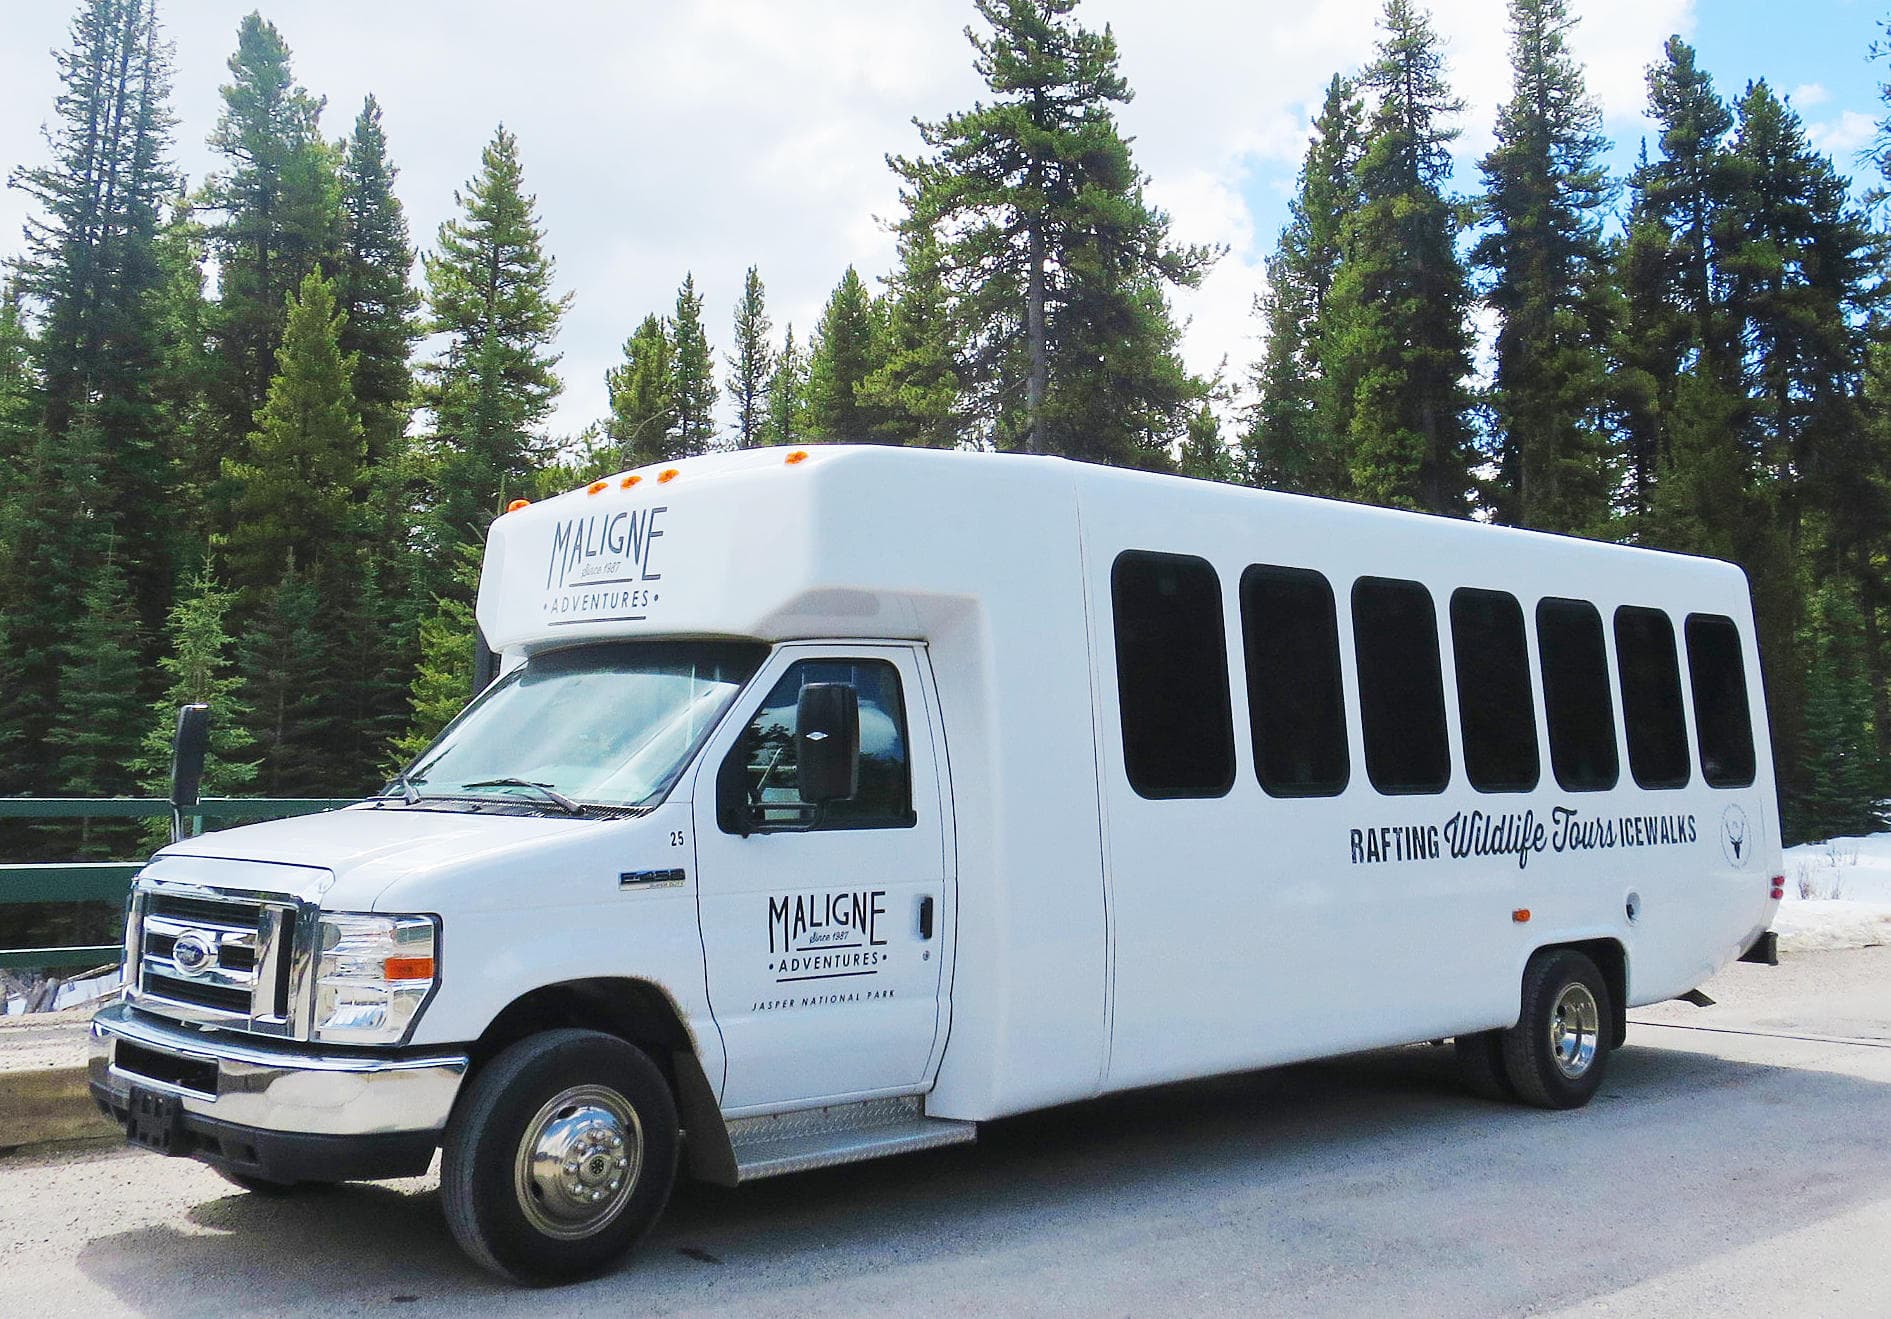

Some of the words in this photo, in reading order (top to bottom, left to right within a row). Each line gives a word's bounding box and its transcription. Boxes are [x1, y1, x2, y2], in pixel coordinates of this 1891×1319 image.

[547, 506, 668, 591] MALIGNE
[550, 590, 649, 614] ADVENTURES
[670, 830, 684, 847] 25
[1350, 825, 1440, 864] RAFTING
[1443, 809, 1548, 870] Wildlife
[1552, 806, 1618, 853] Tours
[1619, 814, 1698, 848] ICEWALKS
[768, 890, 888, 954] MALIGNE
[778, 951, 878, 973] ADVENTURES
[752, 999, 795, 1012] JASPER
[801, 992, 860, 1007] NATIONAL
[867, 989, 896, 1000] PARK
